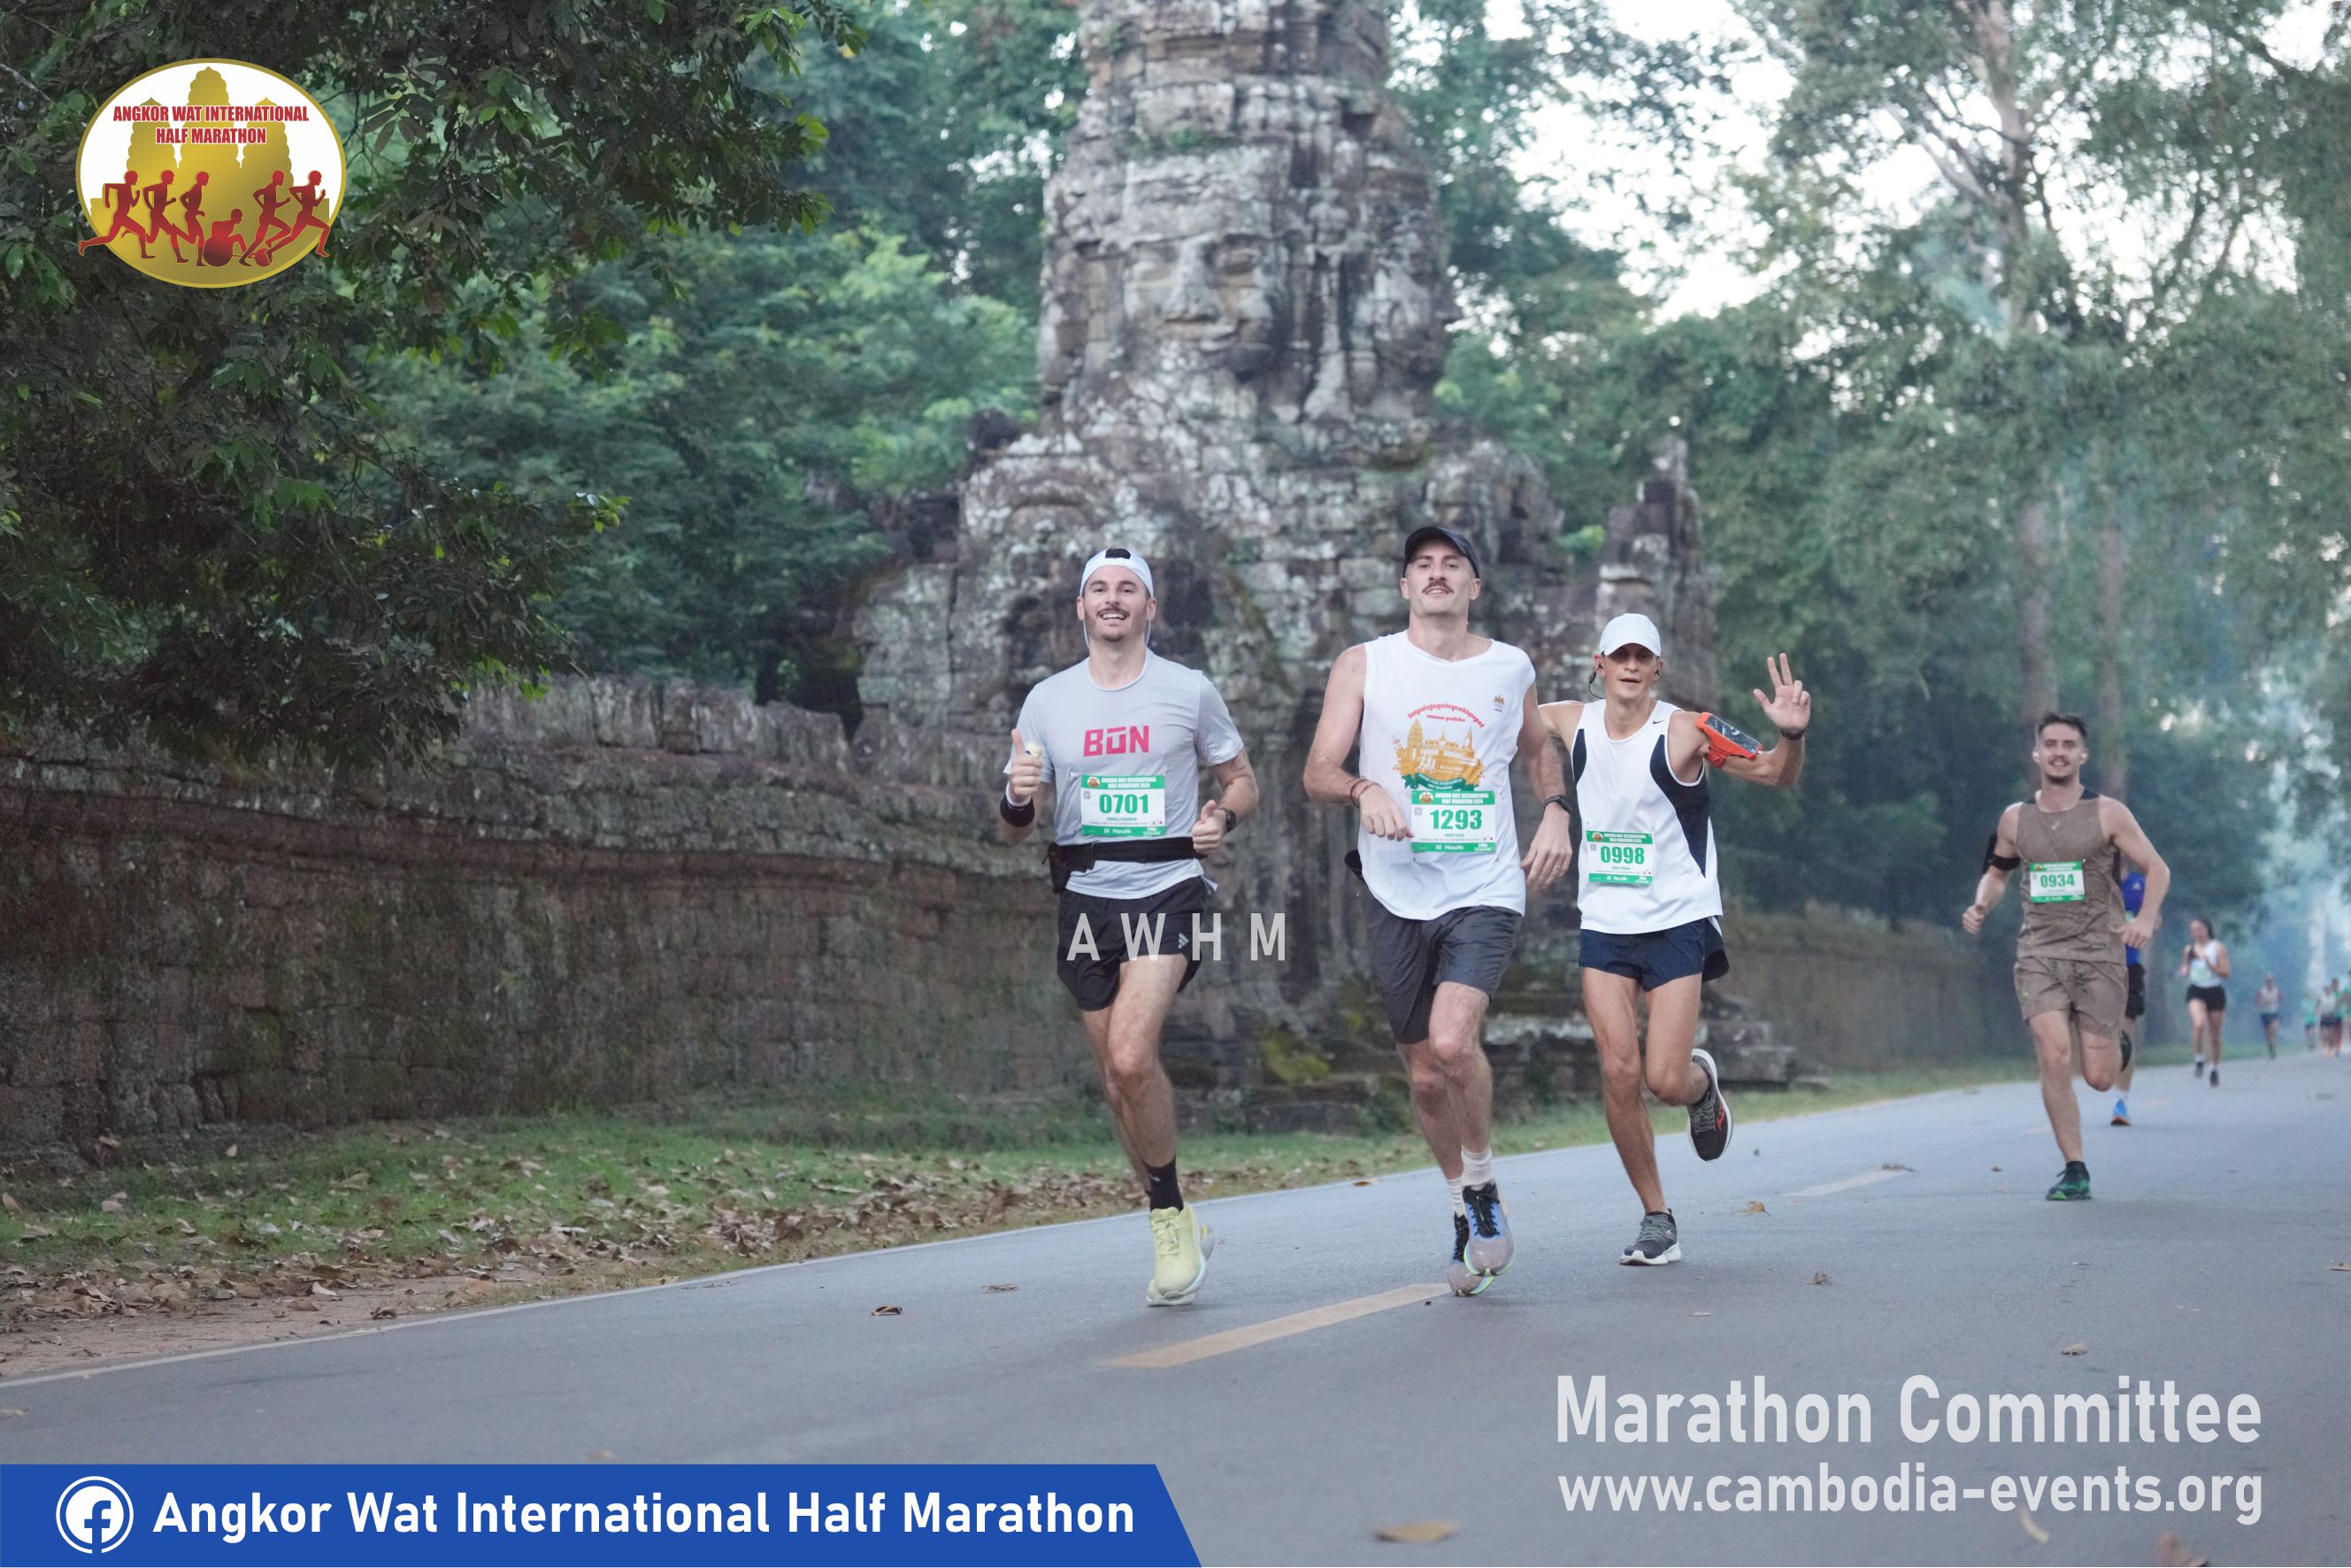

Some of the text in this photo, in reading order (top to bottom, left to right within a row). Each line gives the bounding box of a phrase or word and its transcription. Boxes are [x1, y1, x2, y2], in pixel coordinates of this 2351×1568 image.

[1099, 793, 1149, 814] 0701
[1430, 809, 1482, 830] 1293
[1600, 845, 1645, 865] 0998
[2040, 874, 2076, 888] 0934
